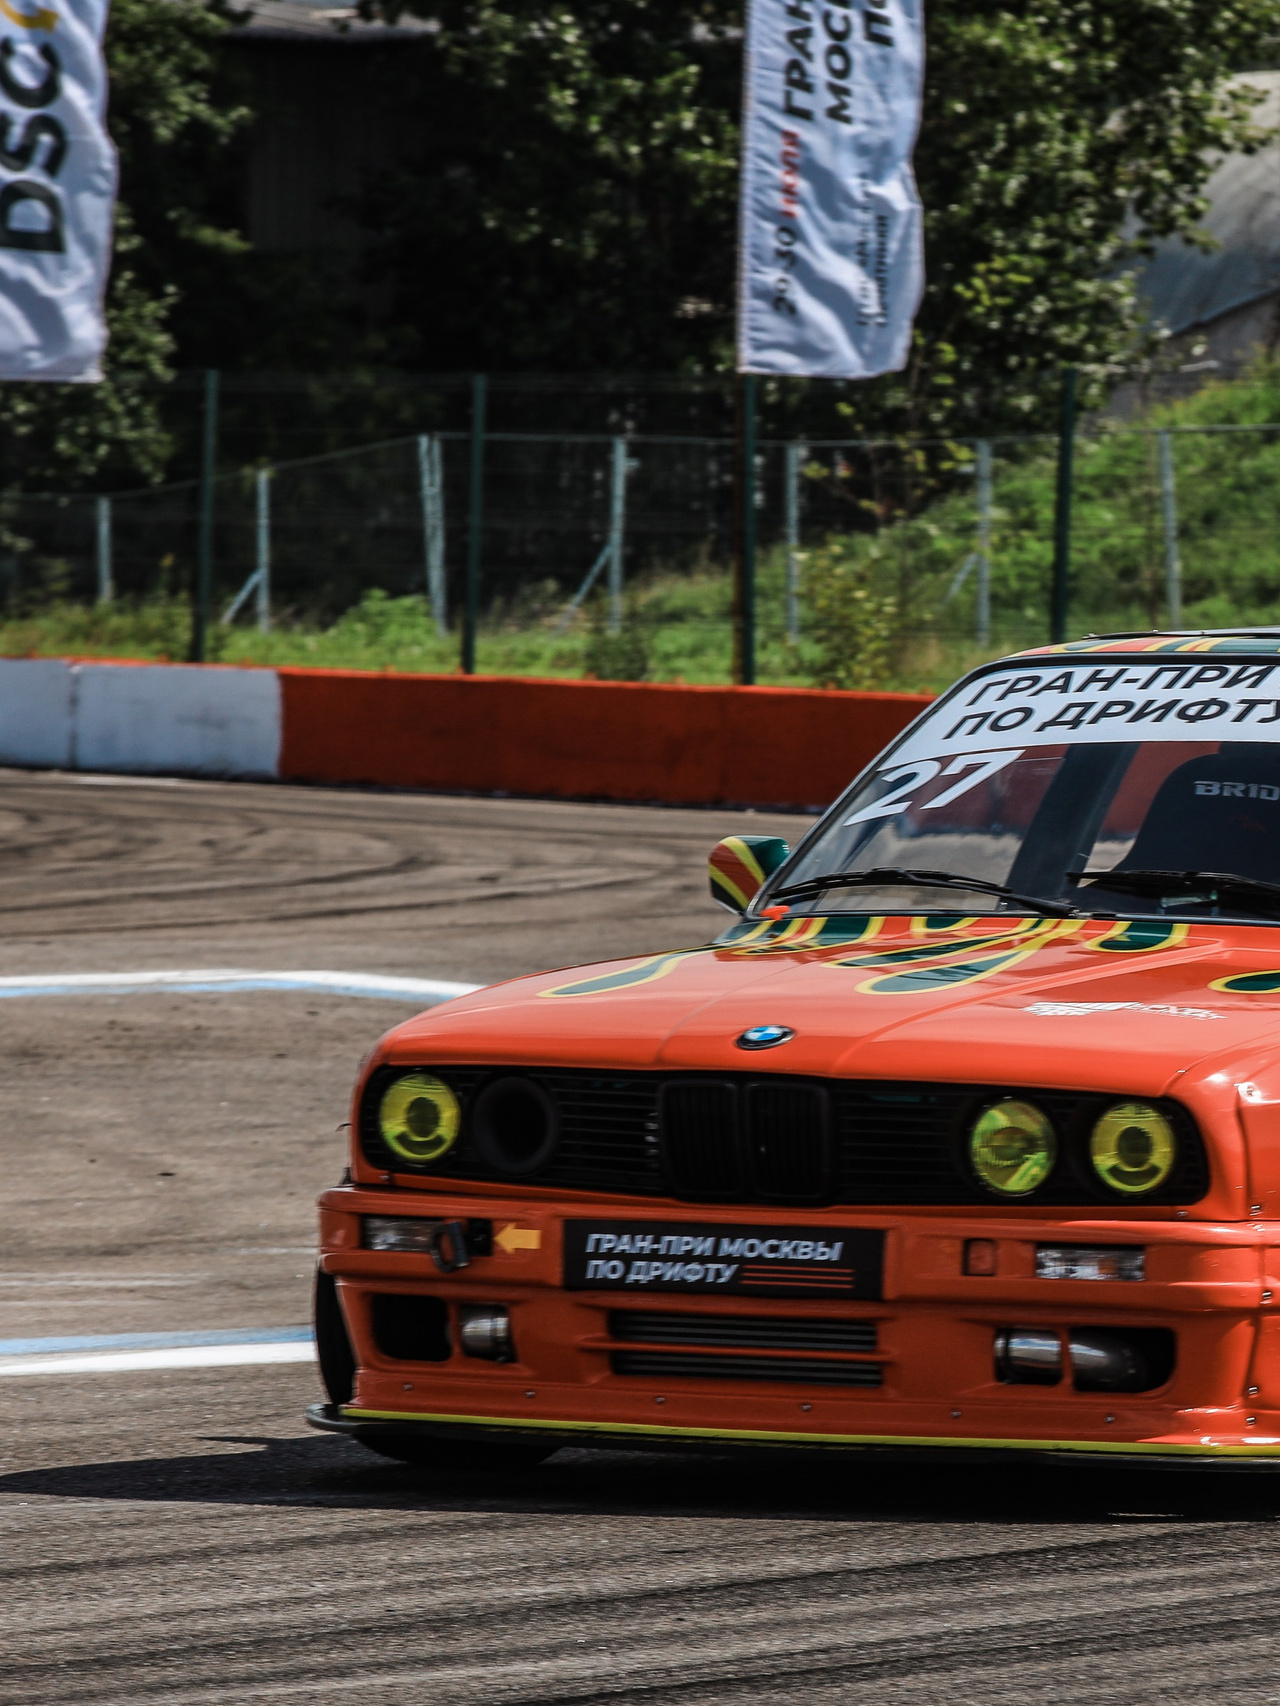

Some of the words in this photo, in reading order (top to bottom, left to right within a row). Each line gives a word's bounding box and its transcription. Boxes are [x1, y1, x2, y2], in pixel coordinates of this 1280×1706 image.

[822, 0, 853, 125] МОС
[965, 666, 1276, 706] ГРАН-ПРИ
[942, 706, 1036, 740] ПО
[843, 749, 1027, 827] 27
[585, 1233, 716, 1256] ГРАН-ПРИ
[717, 1237, 844, 1261] МОСКВЫ
[585, 1259, 626, 1279] ПО
[624, 1261, 740, 1284] ДРИФТУ
